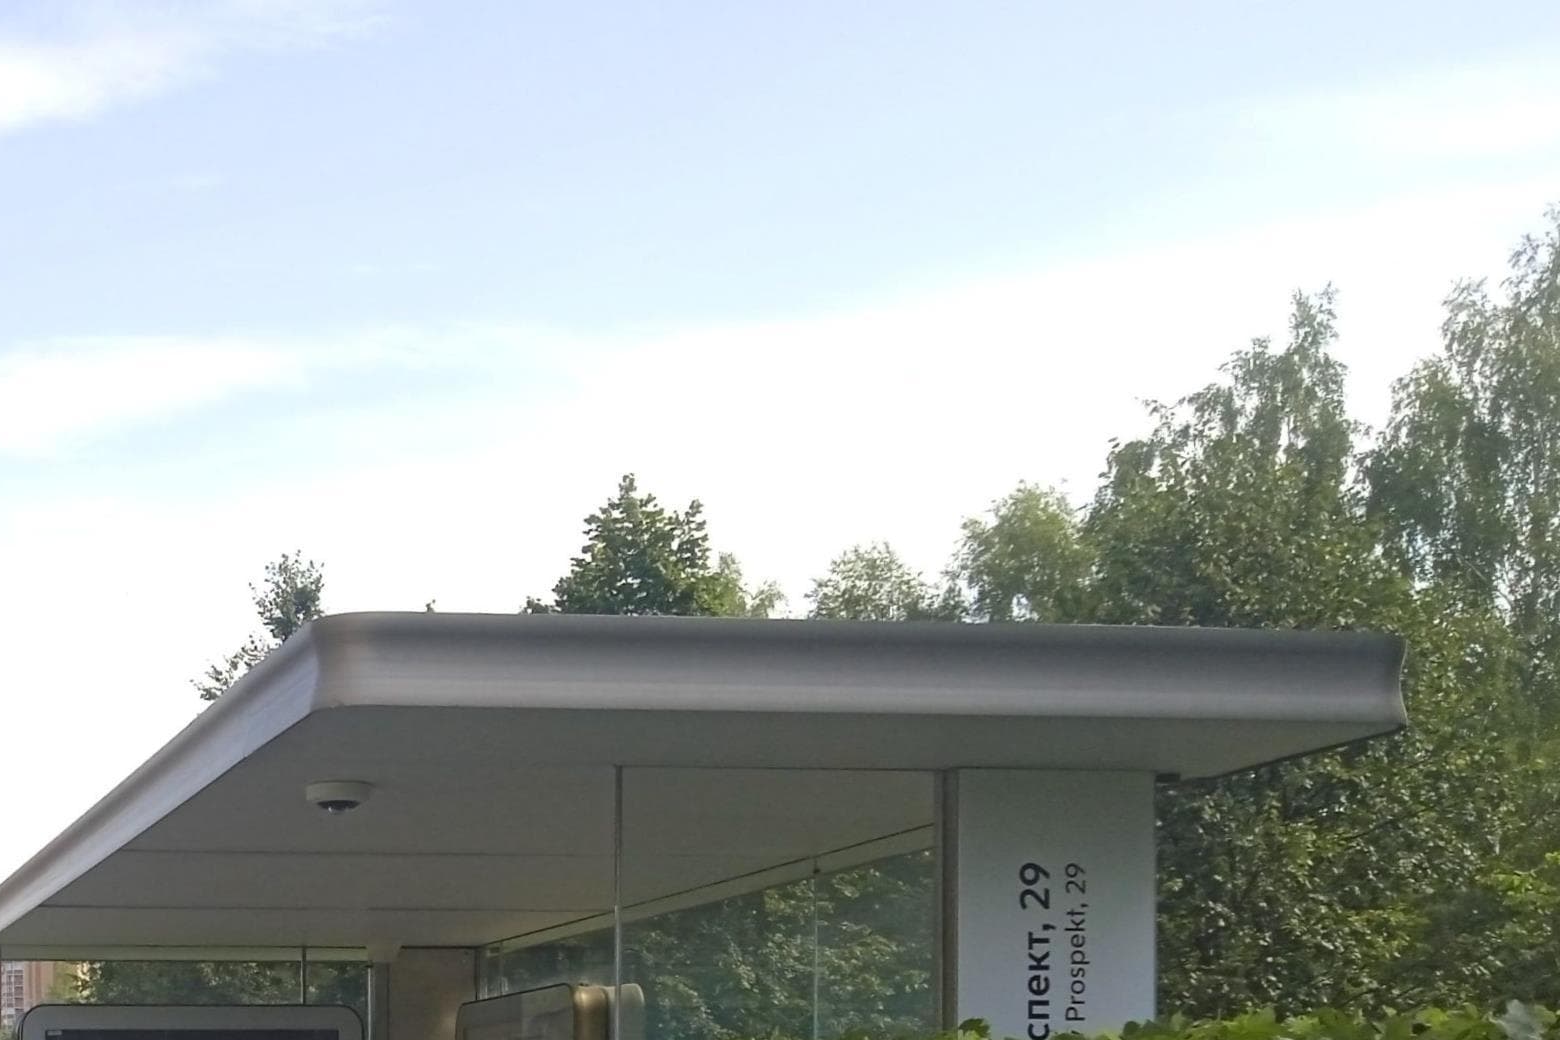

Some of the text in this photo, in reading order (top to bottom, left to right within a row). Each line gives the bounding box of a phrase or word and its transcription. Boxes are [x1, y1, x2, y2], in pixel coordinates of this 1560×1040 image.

[1019, 862, 1050, 910] 29
[1064, 862, 1086, 895] 29
[1064, 903, 1090, 1021] Prospekt,
